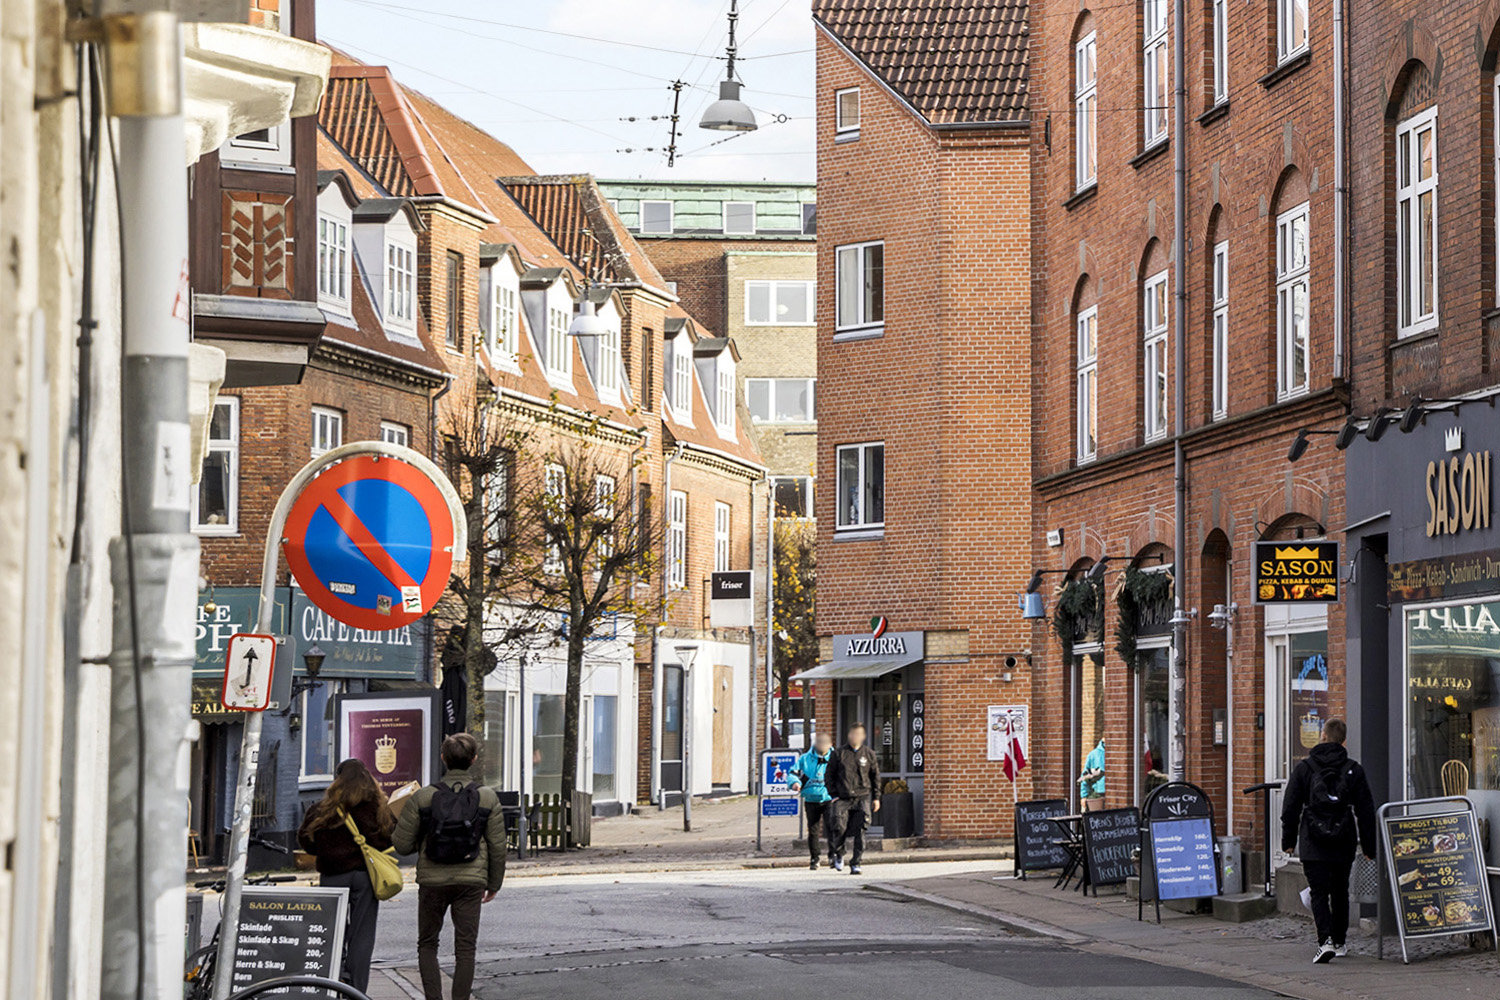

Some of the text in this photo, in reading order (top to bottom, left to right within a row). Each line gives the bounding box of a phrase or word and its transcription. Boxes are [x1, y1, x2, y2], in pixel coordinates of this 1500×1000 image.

[1426, 450, 1490, 538] SASON
[1261, 560, 1334, 576] SASON
[1426, 564, 1446, 587] Kebab
[1450, 558, 1482, 584] Sandwich
[846, 637, 907, 656] AZZURRA
[1182, 794, 1198, 803] City
[249, 901, 323, 911] SALON LAURA
[240, 923, 327, 933] Skinfade 250,-
[238, 936, 271, 945] Skinfade
[271, 936, 278, 944] &
[278, 936, 300, 946] Skæg
[237, 948, 324, 957] Herre 200,-
[235, 960, 323, 970] Herre & Skæg 250,-
